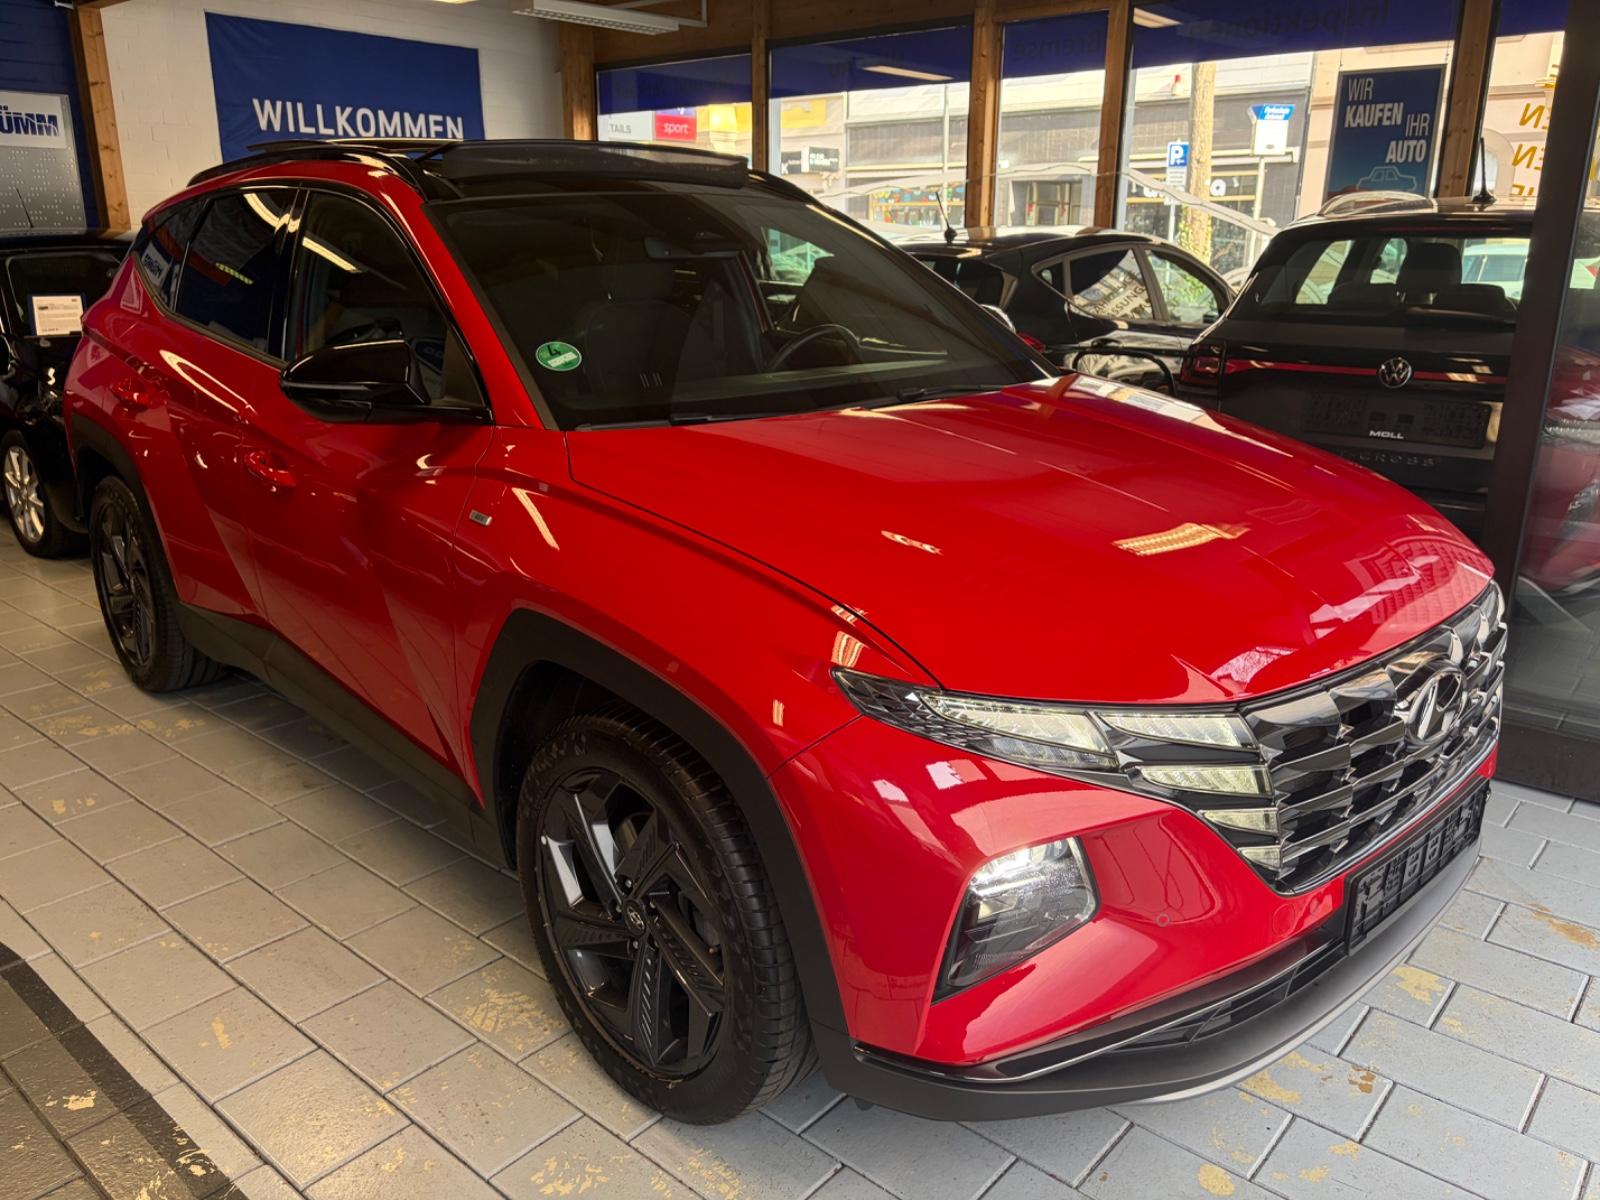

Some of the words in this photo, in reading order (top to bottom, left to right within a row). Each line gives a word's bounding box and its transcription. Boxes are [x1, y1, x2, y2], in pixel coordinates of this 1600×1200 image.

[1348, 78, 1374, 101] WIR
[252, 98, 464, 139] WILLKOMMEN
[1344, 102, 1404, 128] KAUFEN
[1405, 113, 1430, 137] IHR
[663, 121, 689, 134] sport
[1385, 139, 1427, 163] AUTO
[1369, 430, 1405, 440] MOLL
